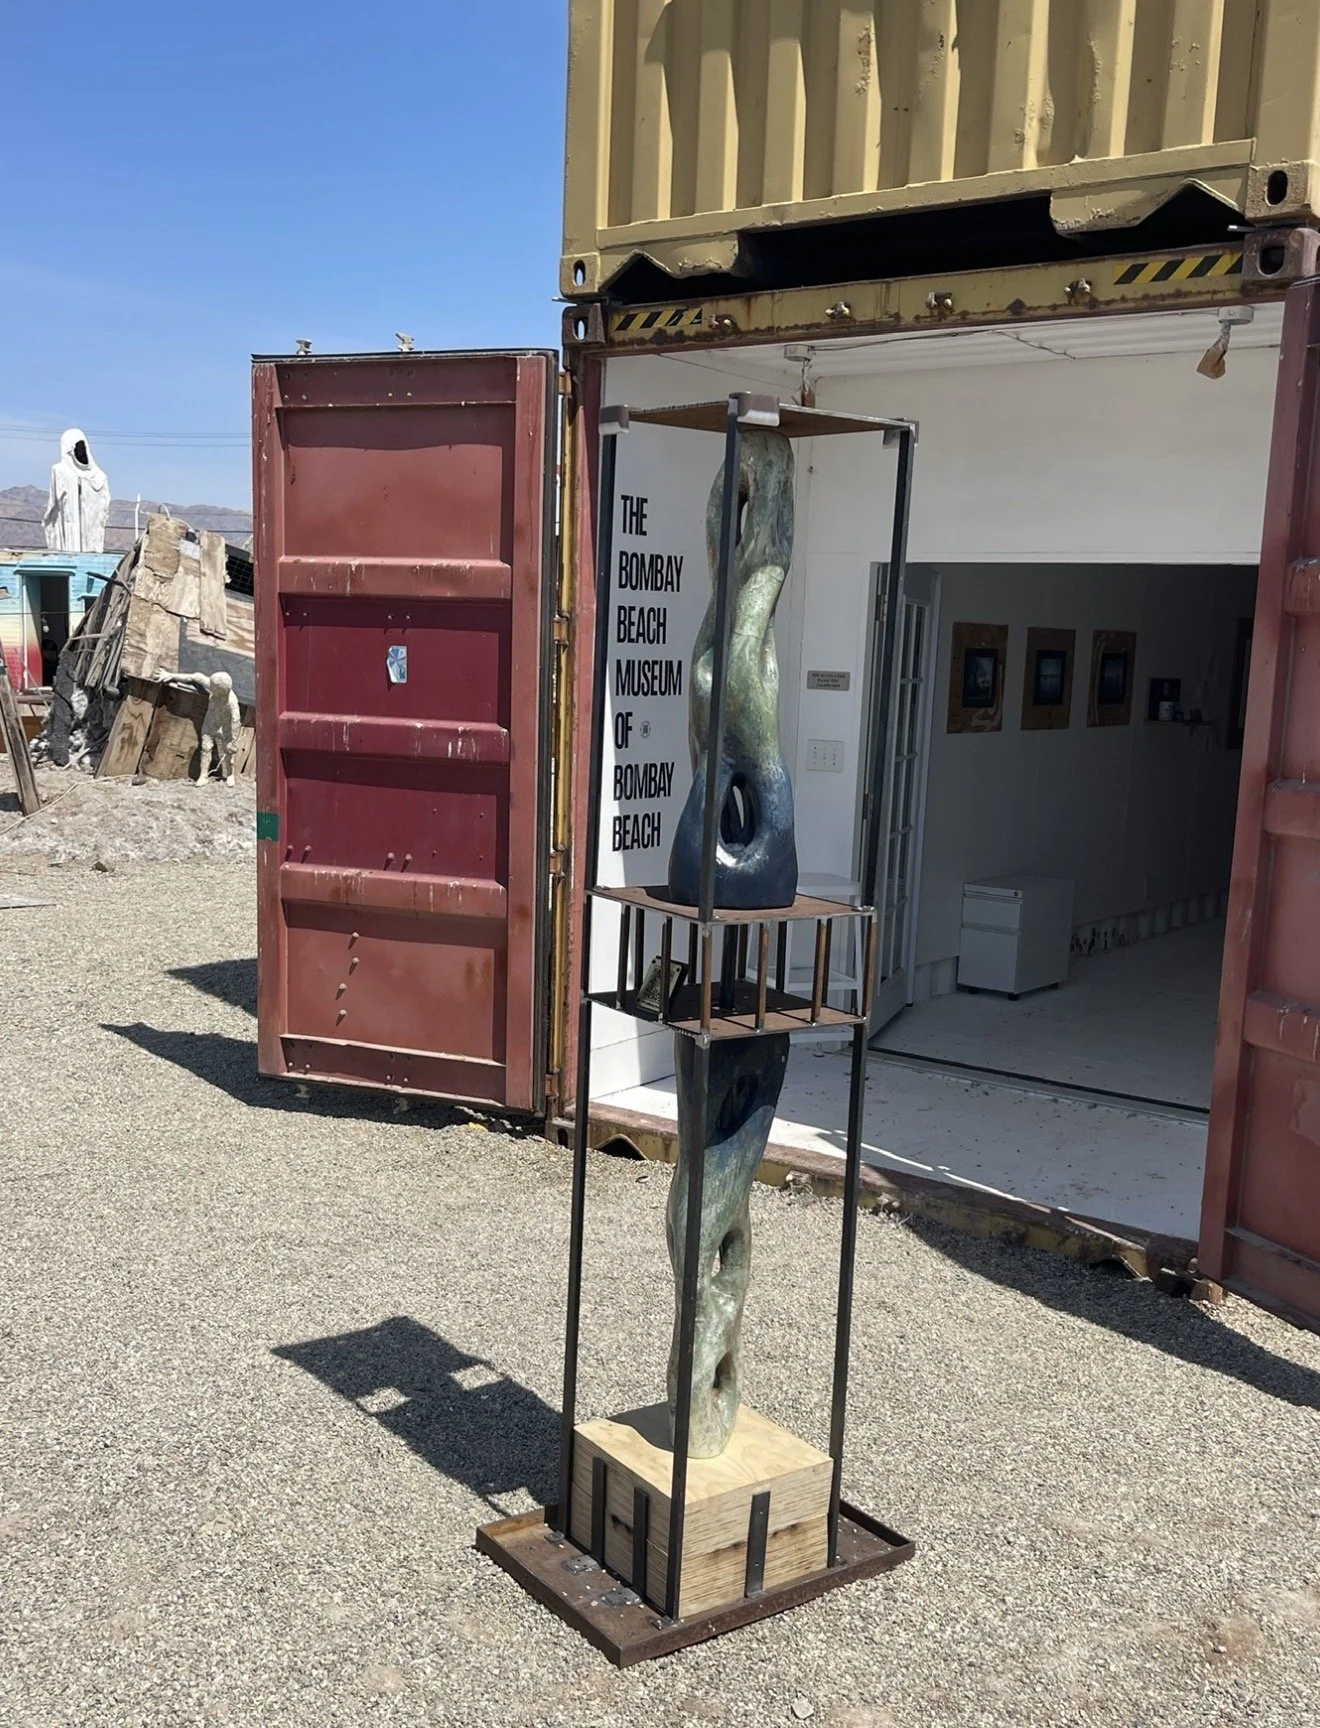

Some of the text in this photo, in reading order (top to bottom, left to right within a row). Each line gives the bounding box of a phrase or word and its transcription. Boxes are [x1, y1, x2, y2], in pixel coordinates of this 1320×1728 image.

[621, 495, 648, 535] THE
[618, 551, 683, 592] BOMBAY
[616, 605, 667, 645] BEACH
[615, 659, 683, 697] MUSEUM
[614, 711, 634, 750] OF
[613, 761, 675, 802] BOMBAY
[612, 811, 662, 852] BEACH
